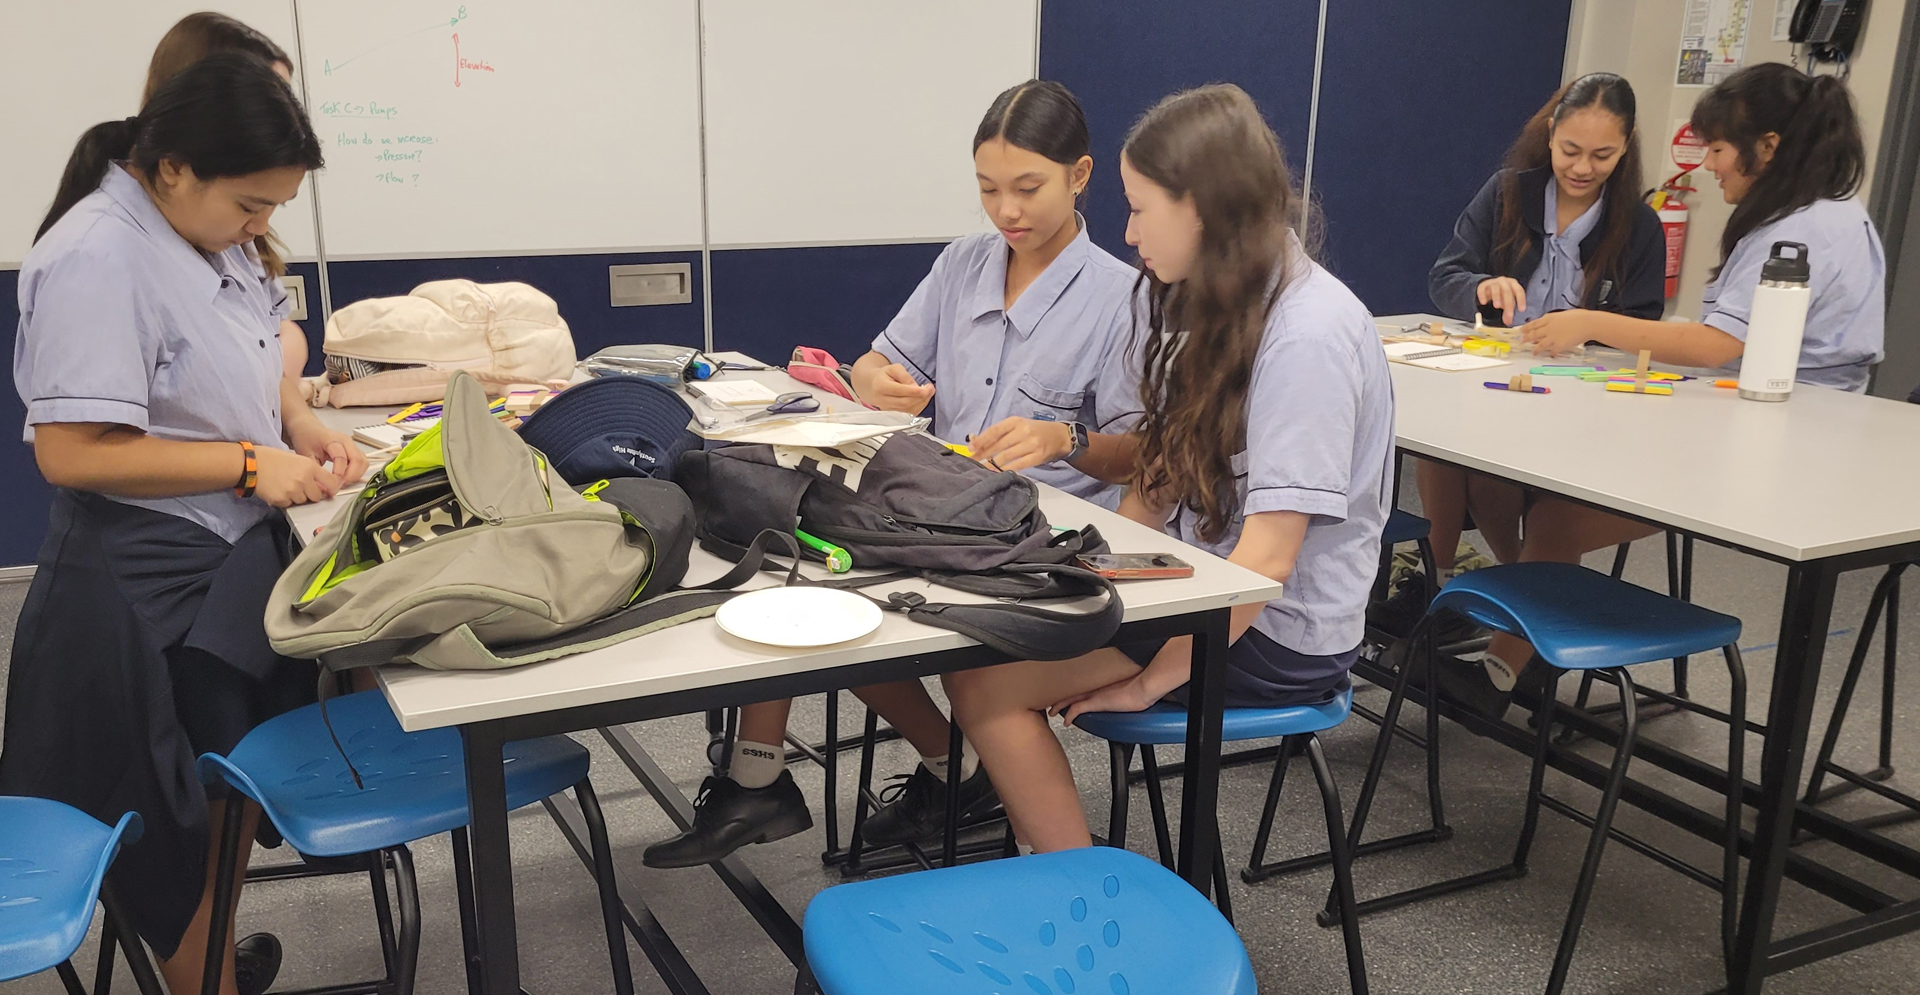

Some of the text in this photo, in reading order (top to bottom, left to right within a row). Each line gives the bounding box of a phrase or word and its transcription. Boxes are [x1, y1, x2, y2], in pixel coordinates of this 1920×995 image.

[458, 5, 467, 20] B
[324, 59, 332, 76] A
[460, 58, 495, 73] Elevation
[344, 102, 353, 114] C
[369, 101, 398, 120] Pumps
[338, 132, 357, 147] How
[362, 132, 373, 145] do
[742, 748, 775, 760] SSHS
